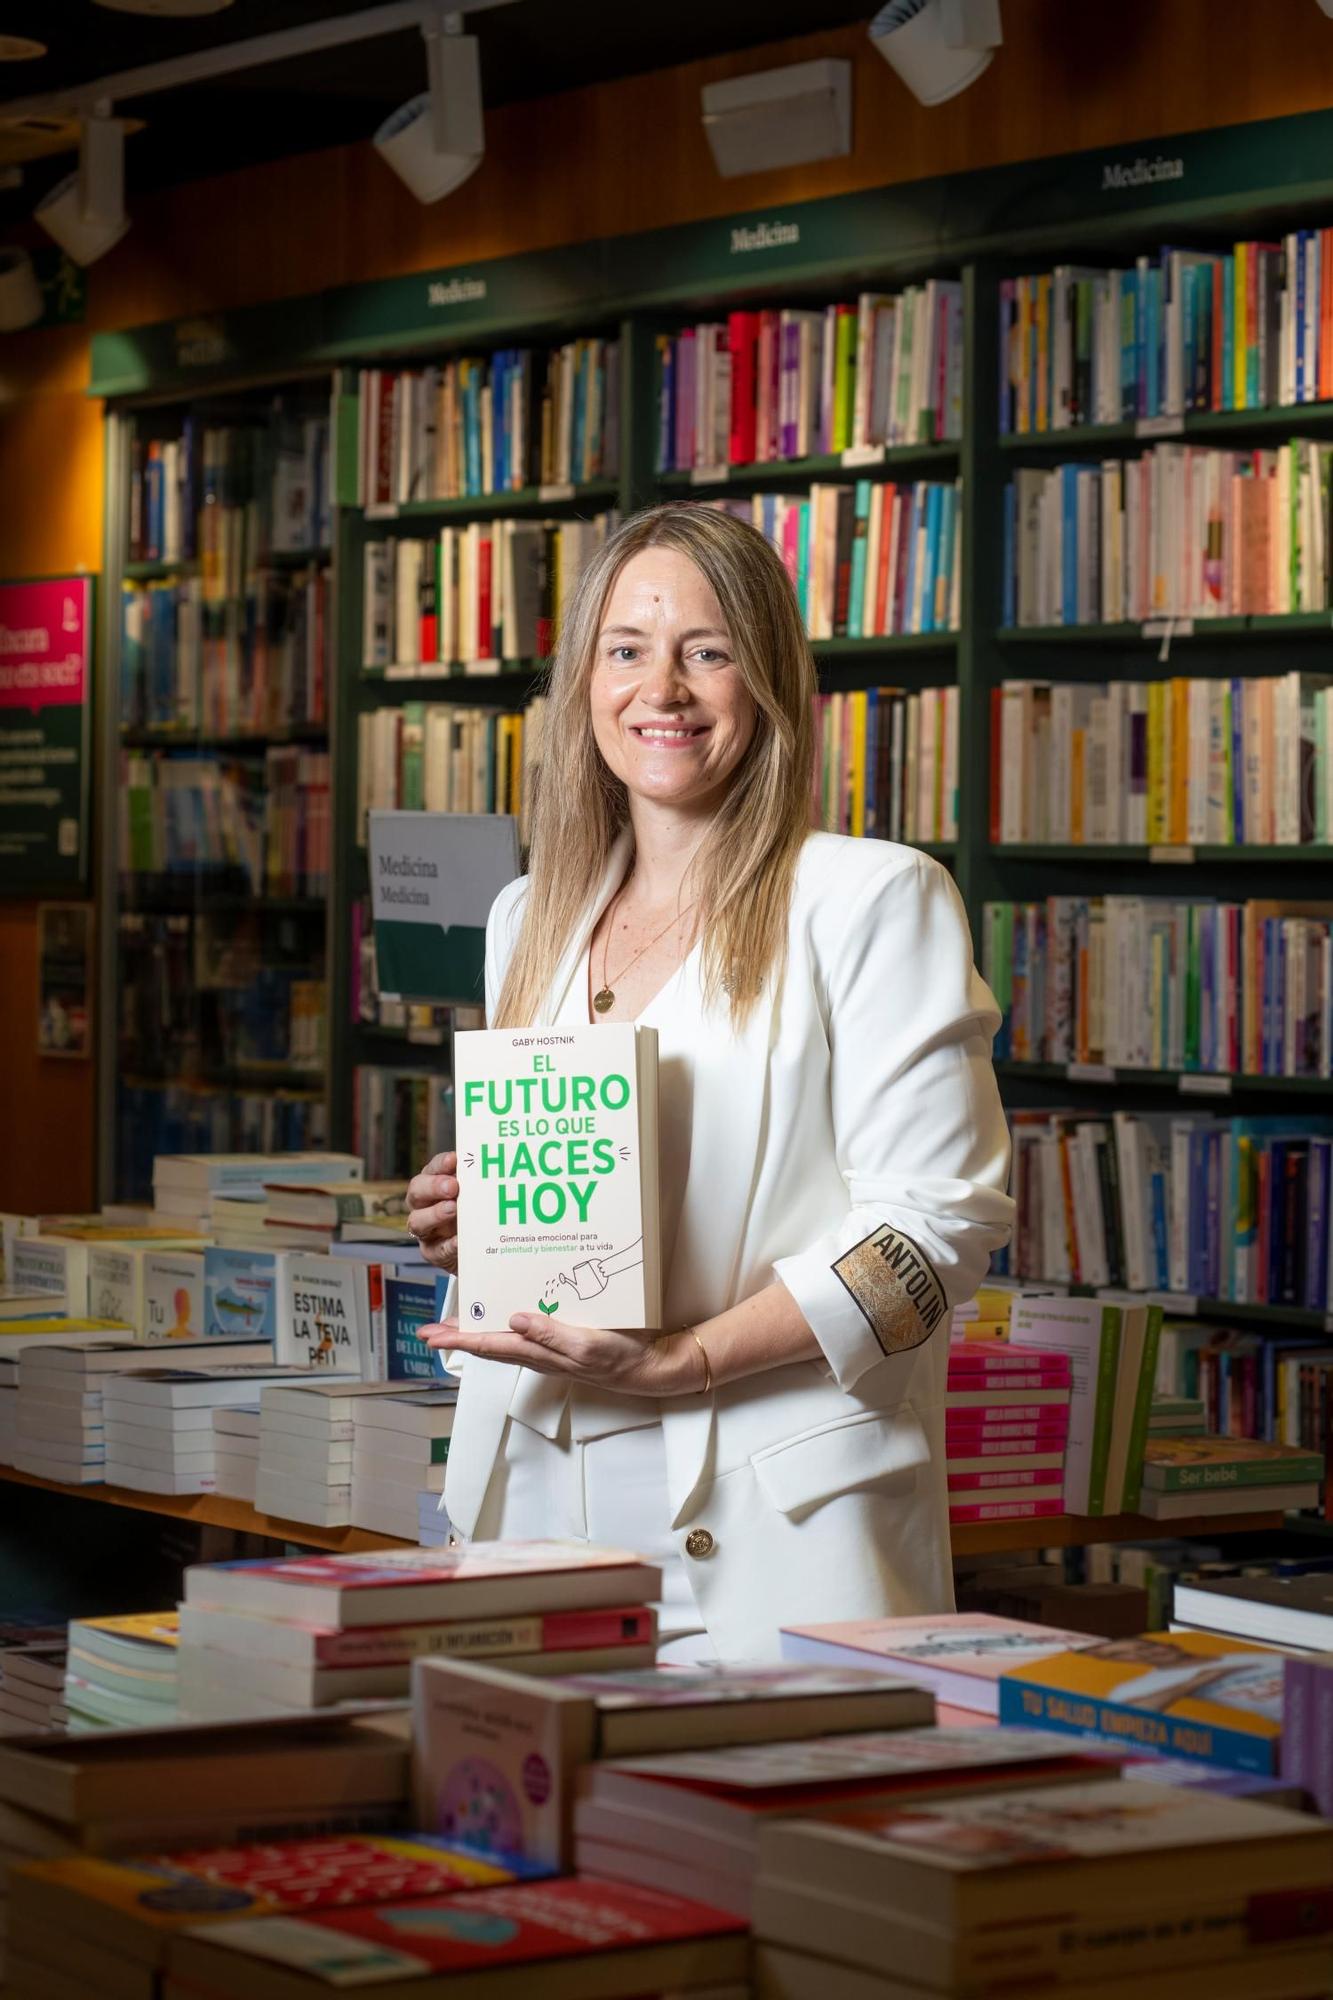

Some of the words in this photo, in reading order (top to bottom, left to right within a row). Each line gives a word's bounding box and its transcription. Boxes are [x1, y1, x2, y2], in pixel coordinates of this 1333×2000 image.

[1102, 156, 1183, 189] Medicina
[731, 221, 799, 253] Medicina
[428, 278, 486, 306] Medicina
[379, 855, 438, 878] Medicina
[381, 886, 430, 906] Medicina
[512, 1038, 535, 1047] GABY
[536, 1036, 575, 1046] HOSTNIK
[533, 1054, 556, 1073] EL
[464, 1073, 631, 1117] FUTURO
[498, 1120, 520, 1137] ES
[526, 1118, 550, 1136] LO
[555, 1116, 596, 1135] QUE
[481, 1138, 616, 1179] HACES
[498, 1180, 599, 1226] HOY
[485, 1246, 499, 1255] dar
[500, 1245, 533, 1255] plenitud
[534, 1246, 539, 1254] y
[541, 1244, 578, 1253] bienestar
[597, 1243, 614, 1251] vida
[500, 1235, 536, 1243] Gimnasia
[537, 1233, 579, 1242] emocional
[580, 1233, 598, 1242] para
[872, 1233, 943, 1330] ANTOLIN
[293, 1292, 346, 1319] ESTIMA
[293, 1318, 311, 1340] LA
[315, 1321, 351, 1346] TEVA
[1178, 1469, 1203, 1485] Ser
[1204, 1465, 1238, 1483] bebé
[1021, 1690, 1042, 1716] TU
[1047, 1696, 1096, 1729] SALUD
[1101, 1708, 1168, 1744] EMPIEZA
[1174, 1726, 1213, 1757] AQUÍ
